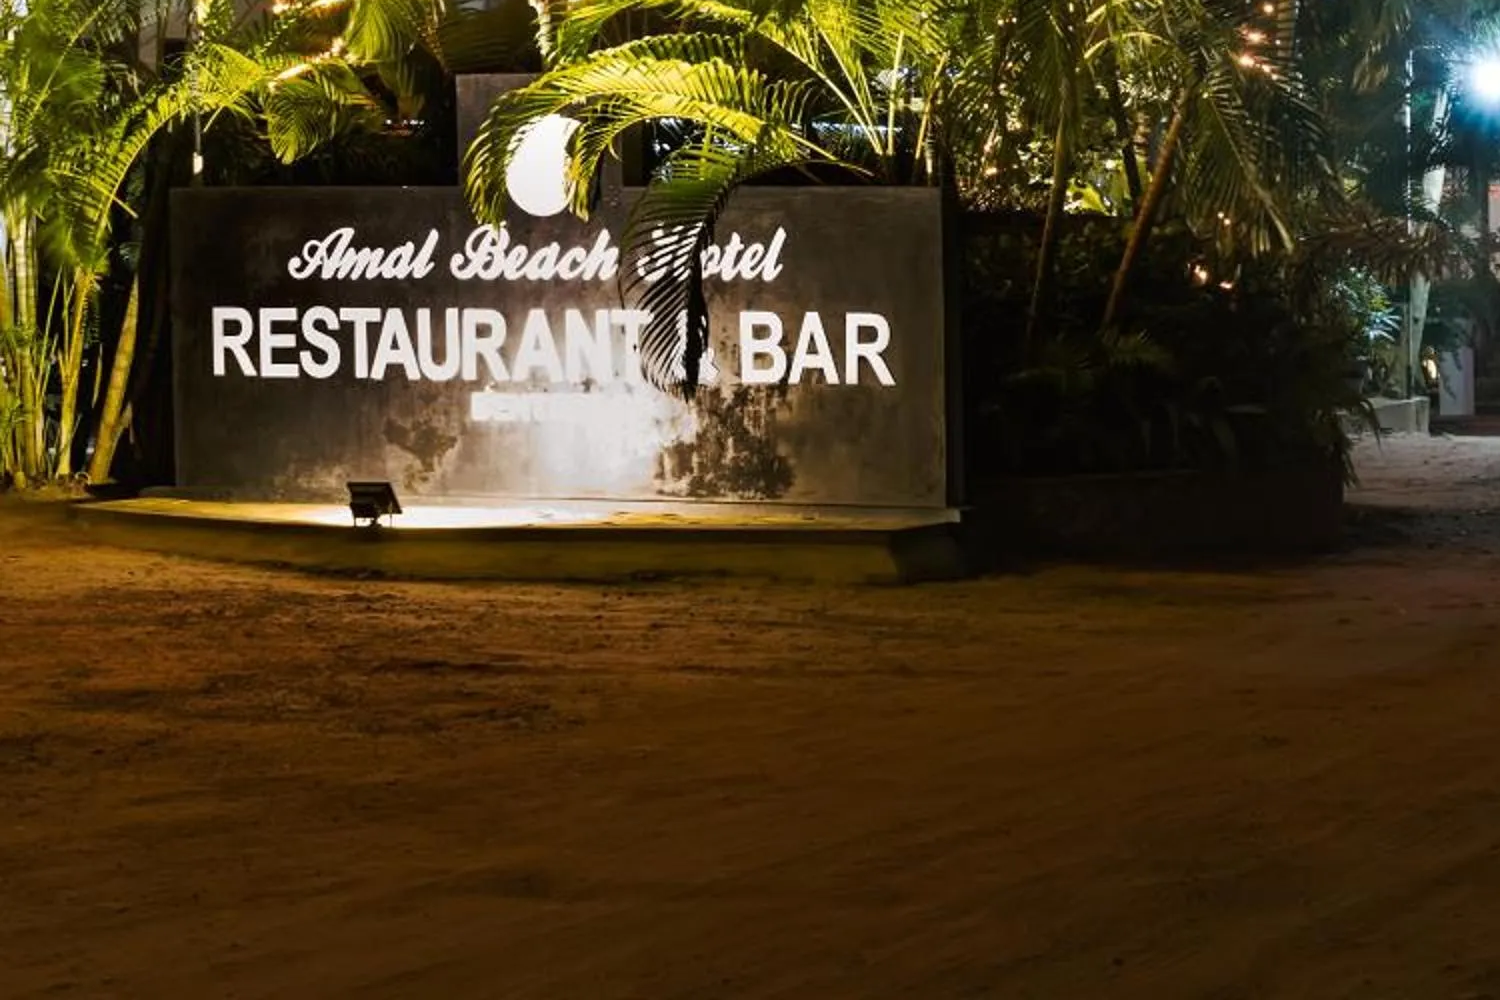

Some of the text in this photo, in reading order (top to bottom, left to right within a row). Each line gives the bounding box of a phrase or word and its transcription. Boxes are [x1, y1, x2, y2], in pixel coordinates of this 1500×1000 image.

[287, 226, 439, 280] Amal
[449, 221, 619, 281] Beach
[211, 305, 655, 383] RESTAURANT
[739, 311, 897, 386] BAR
